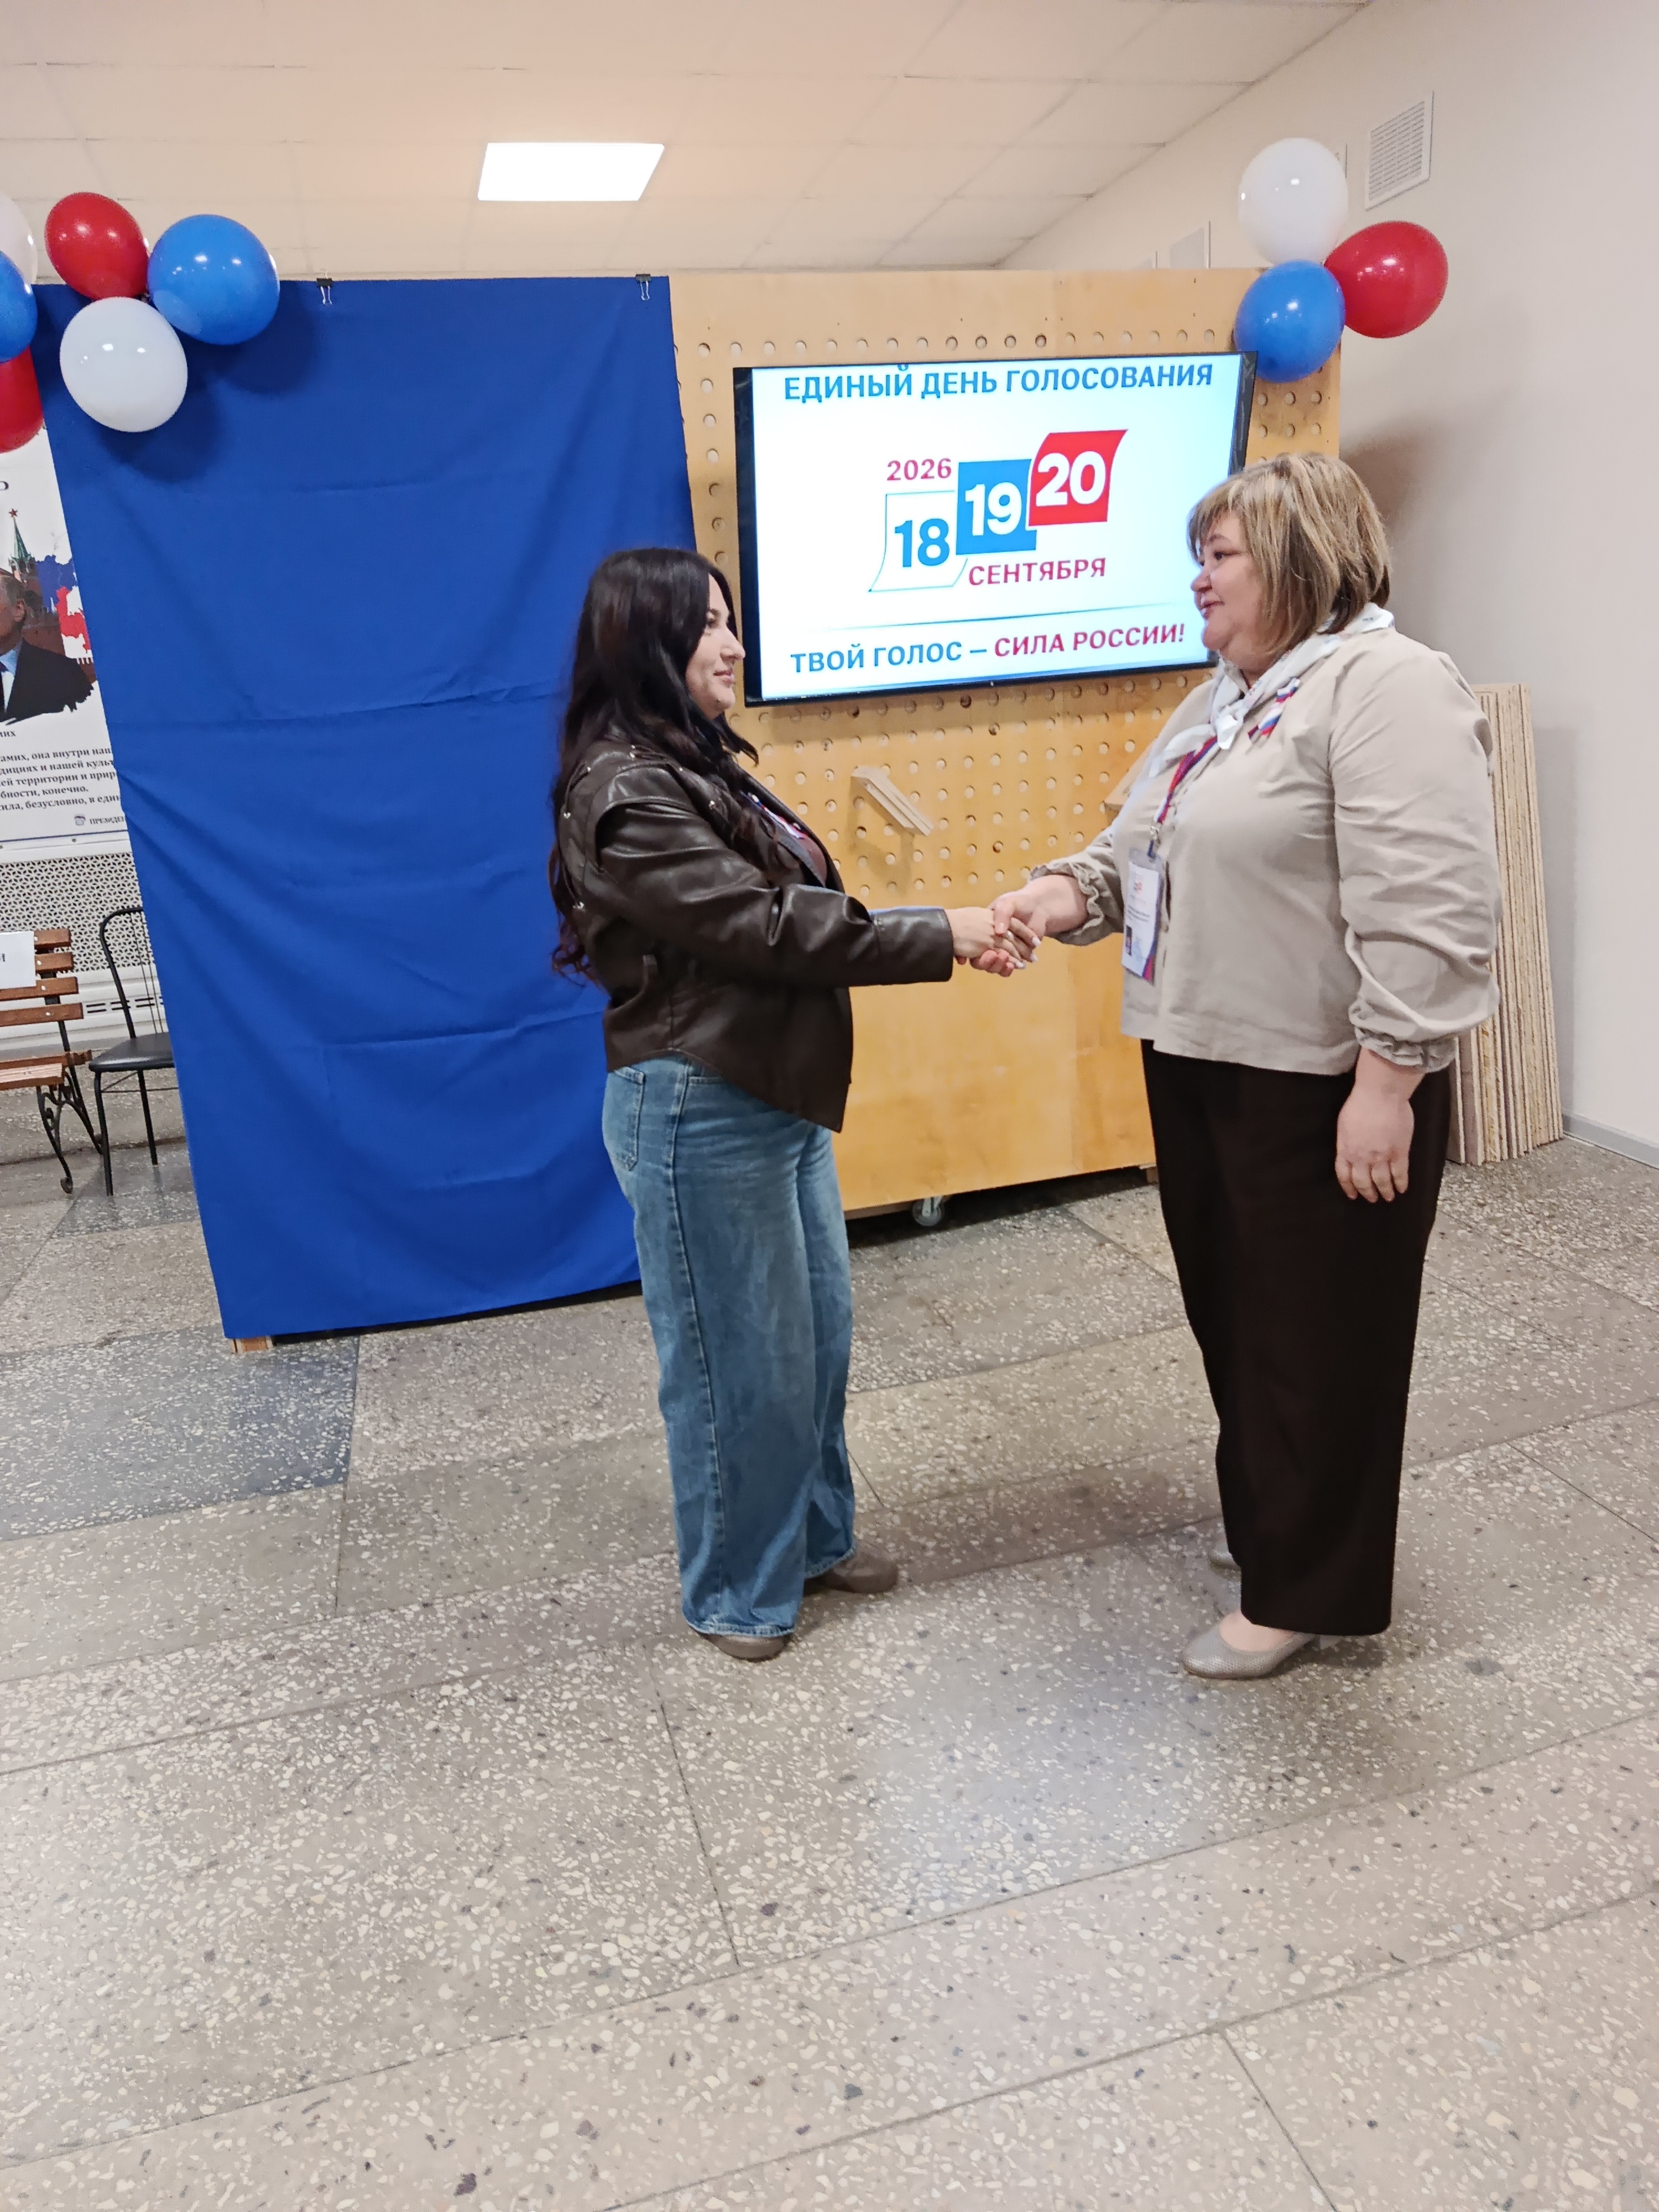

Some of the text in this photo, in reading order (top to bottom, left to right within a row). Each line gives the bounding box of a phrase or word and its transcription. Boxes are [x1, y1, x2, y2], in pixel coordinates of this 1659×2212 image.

[785, 364, 1212, 403] ЕДИНЫЙ ДЕНЬ ГОЛОСОВАНИЯ
[886, 458, 952, 481] 2026
[894, 451, 1107, 568] 18 19 20
[969, 557, 1105, 586] СЕНТЯБРЯ
[790, 643, 864, 673] ТВОЙ
[874, 641, 962, 666] ГОЛОС
[995, 633, 1065, 657] СИЛА
[1073, 623, 1185, 650] РОССИИ!
[53, 749, 90, 759] внутри
[50, 760, 84, 770] нашей
[15, 775, 78, 786] территории
[42, 786, 89, 795] конечно.
[25, 798, 87, 809] безусловно,
